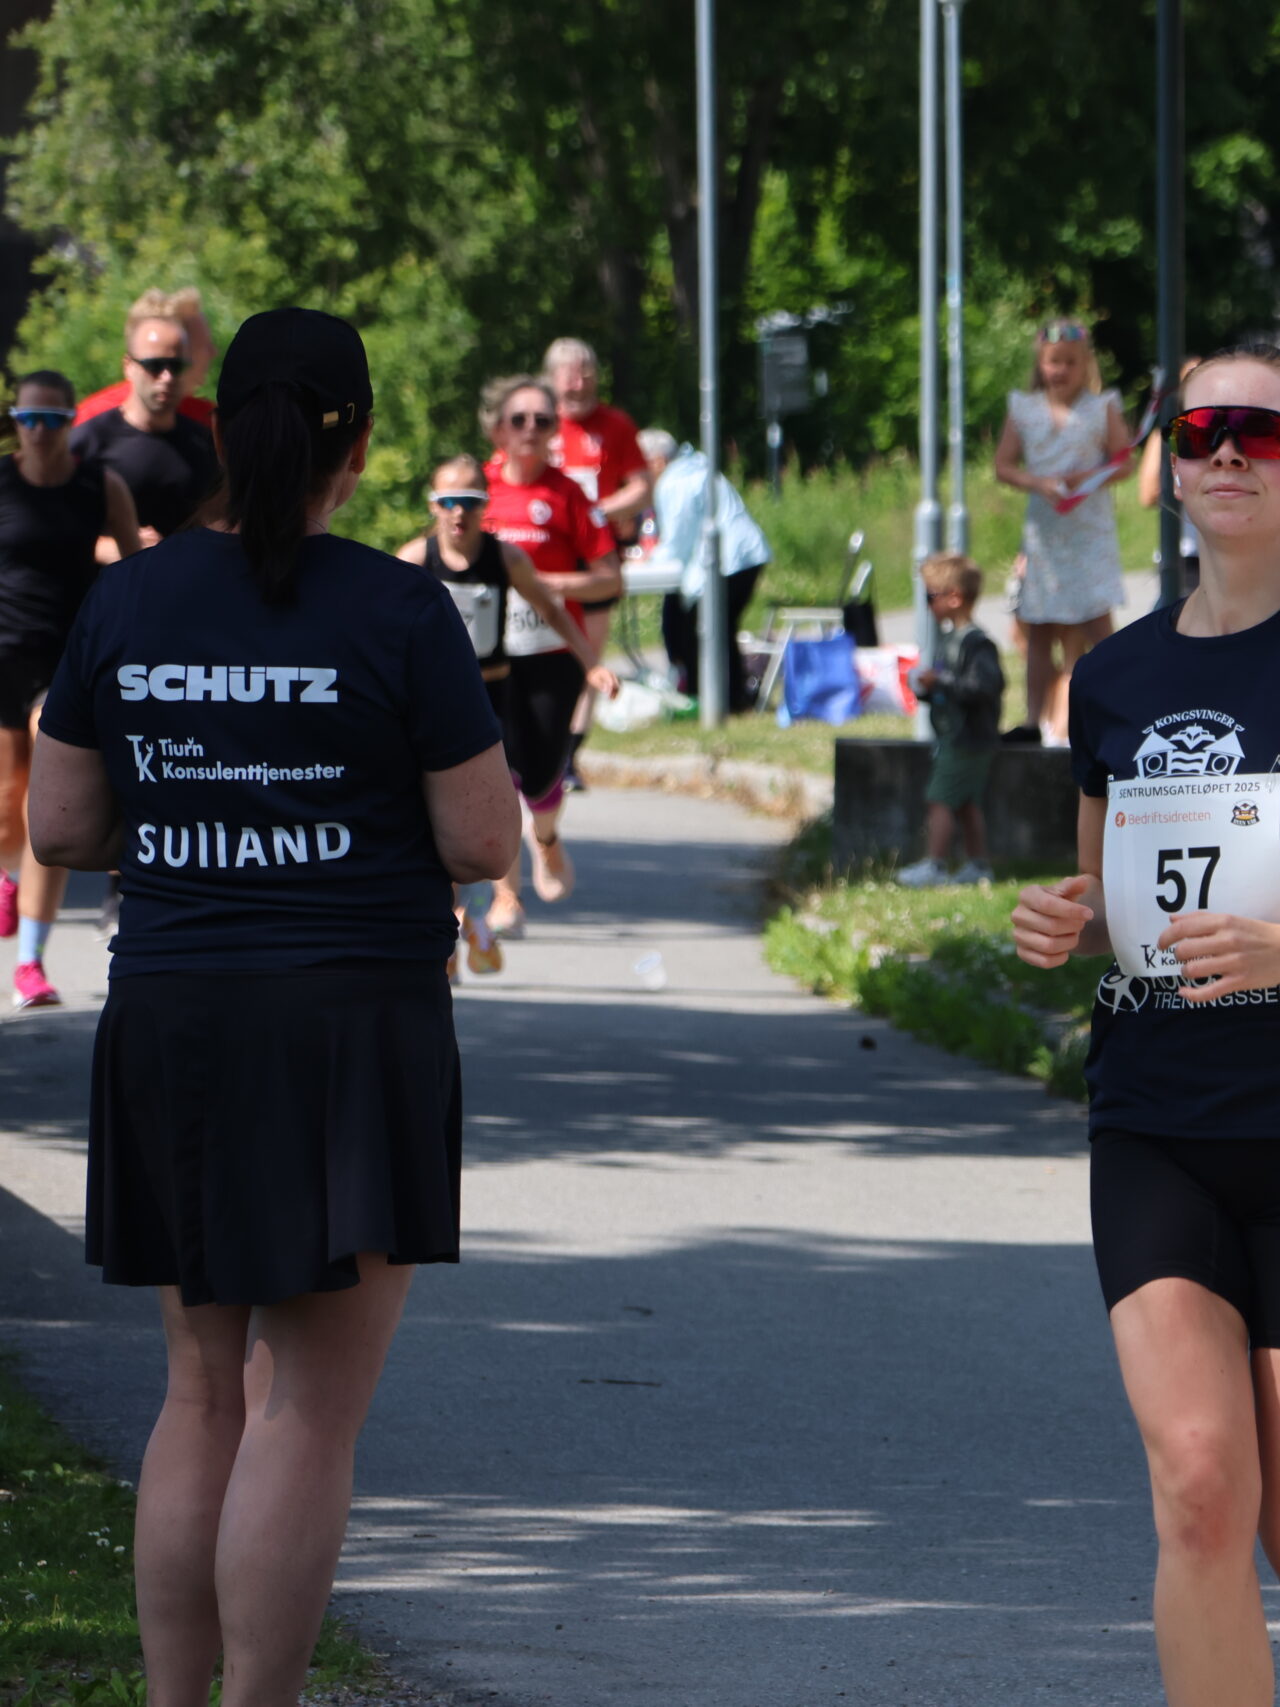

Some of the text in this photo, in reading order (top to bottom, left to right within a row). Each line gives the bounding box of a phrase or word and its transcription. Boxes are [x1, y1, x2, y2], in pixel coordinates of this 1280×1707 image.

[117, 664, 338, 703] SCHÜTZ
[1154, 709, 1237, 729] KONGSVINGER
[162, 761, 345, 785] Konsulenttjenester
[1118, 782, 1261, 799] SENTRUMSGATELØPET 2025
[1128, 810, 1211, 825] Bedriftsidretten
[1156, 846, 1220, 913] 57
